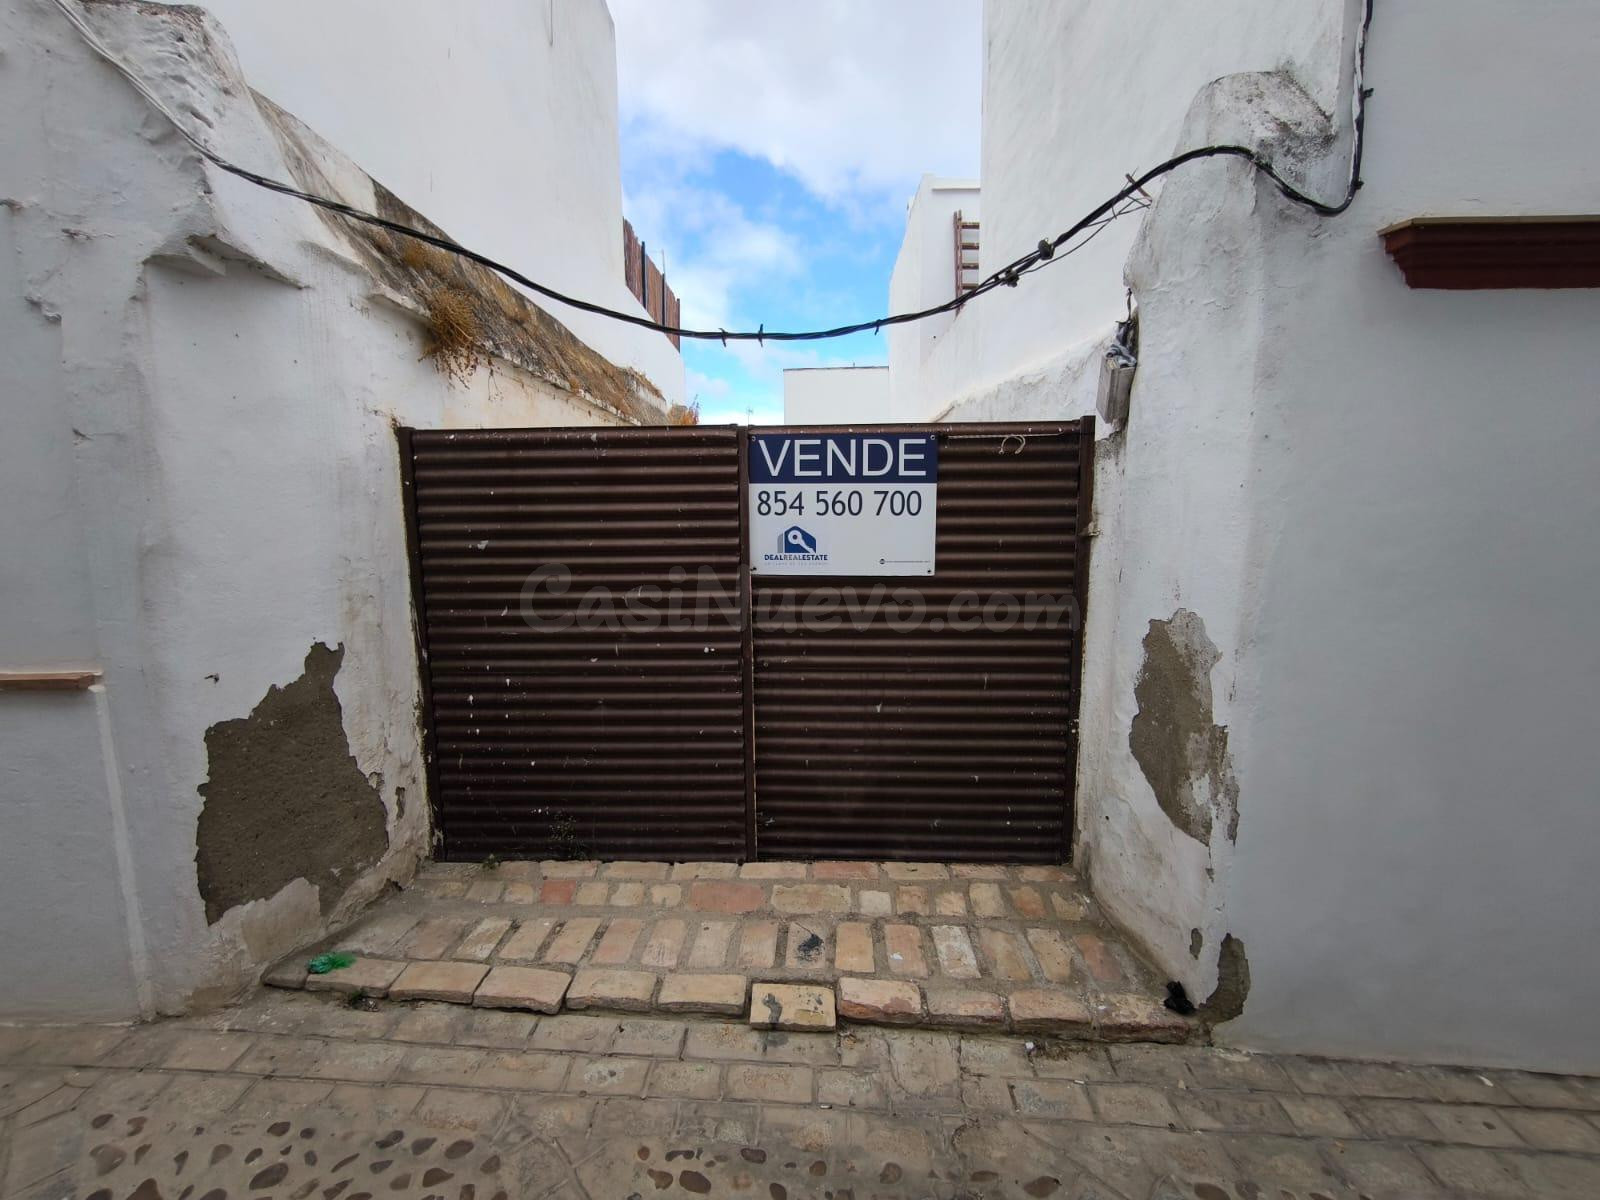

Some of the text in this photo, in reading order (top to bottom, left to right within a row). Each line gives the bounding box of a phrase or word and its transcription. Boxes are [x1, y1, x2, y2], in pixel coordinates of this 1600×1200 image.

[759, 439, 926, 476] VENDE
[757, 490, 922, 516] 854 560 700
